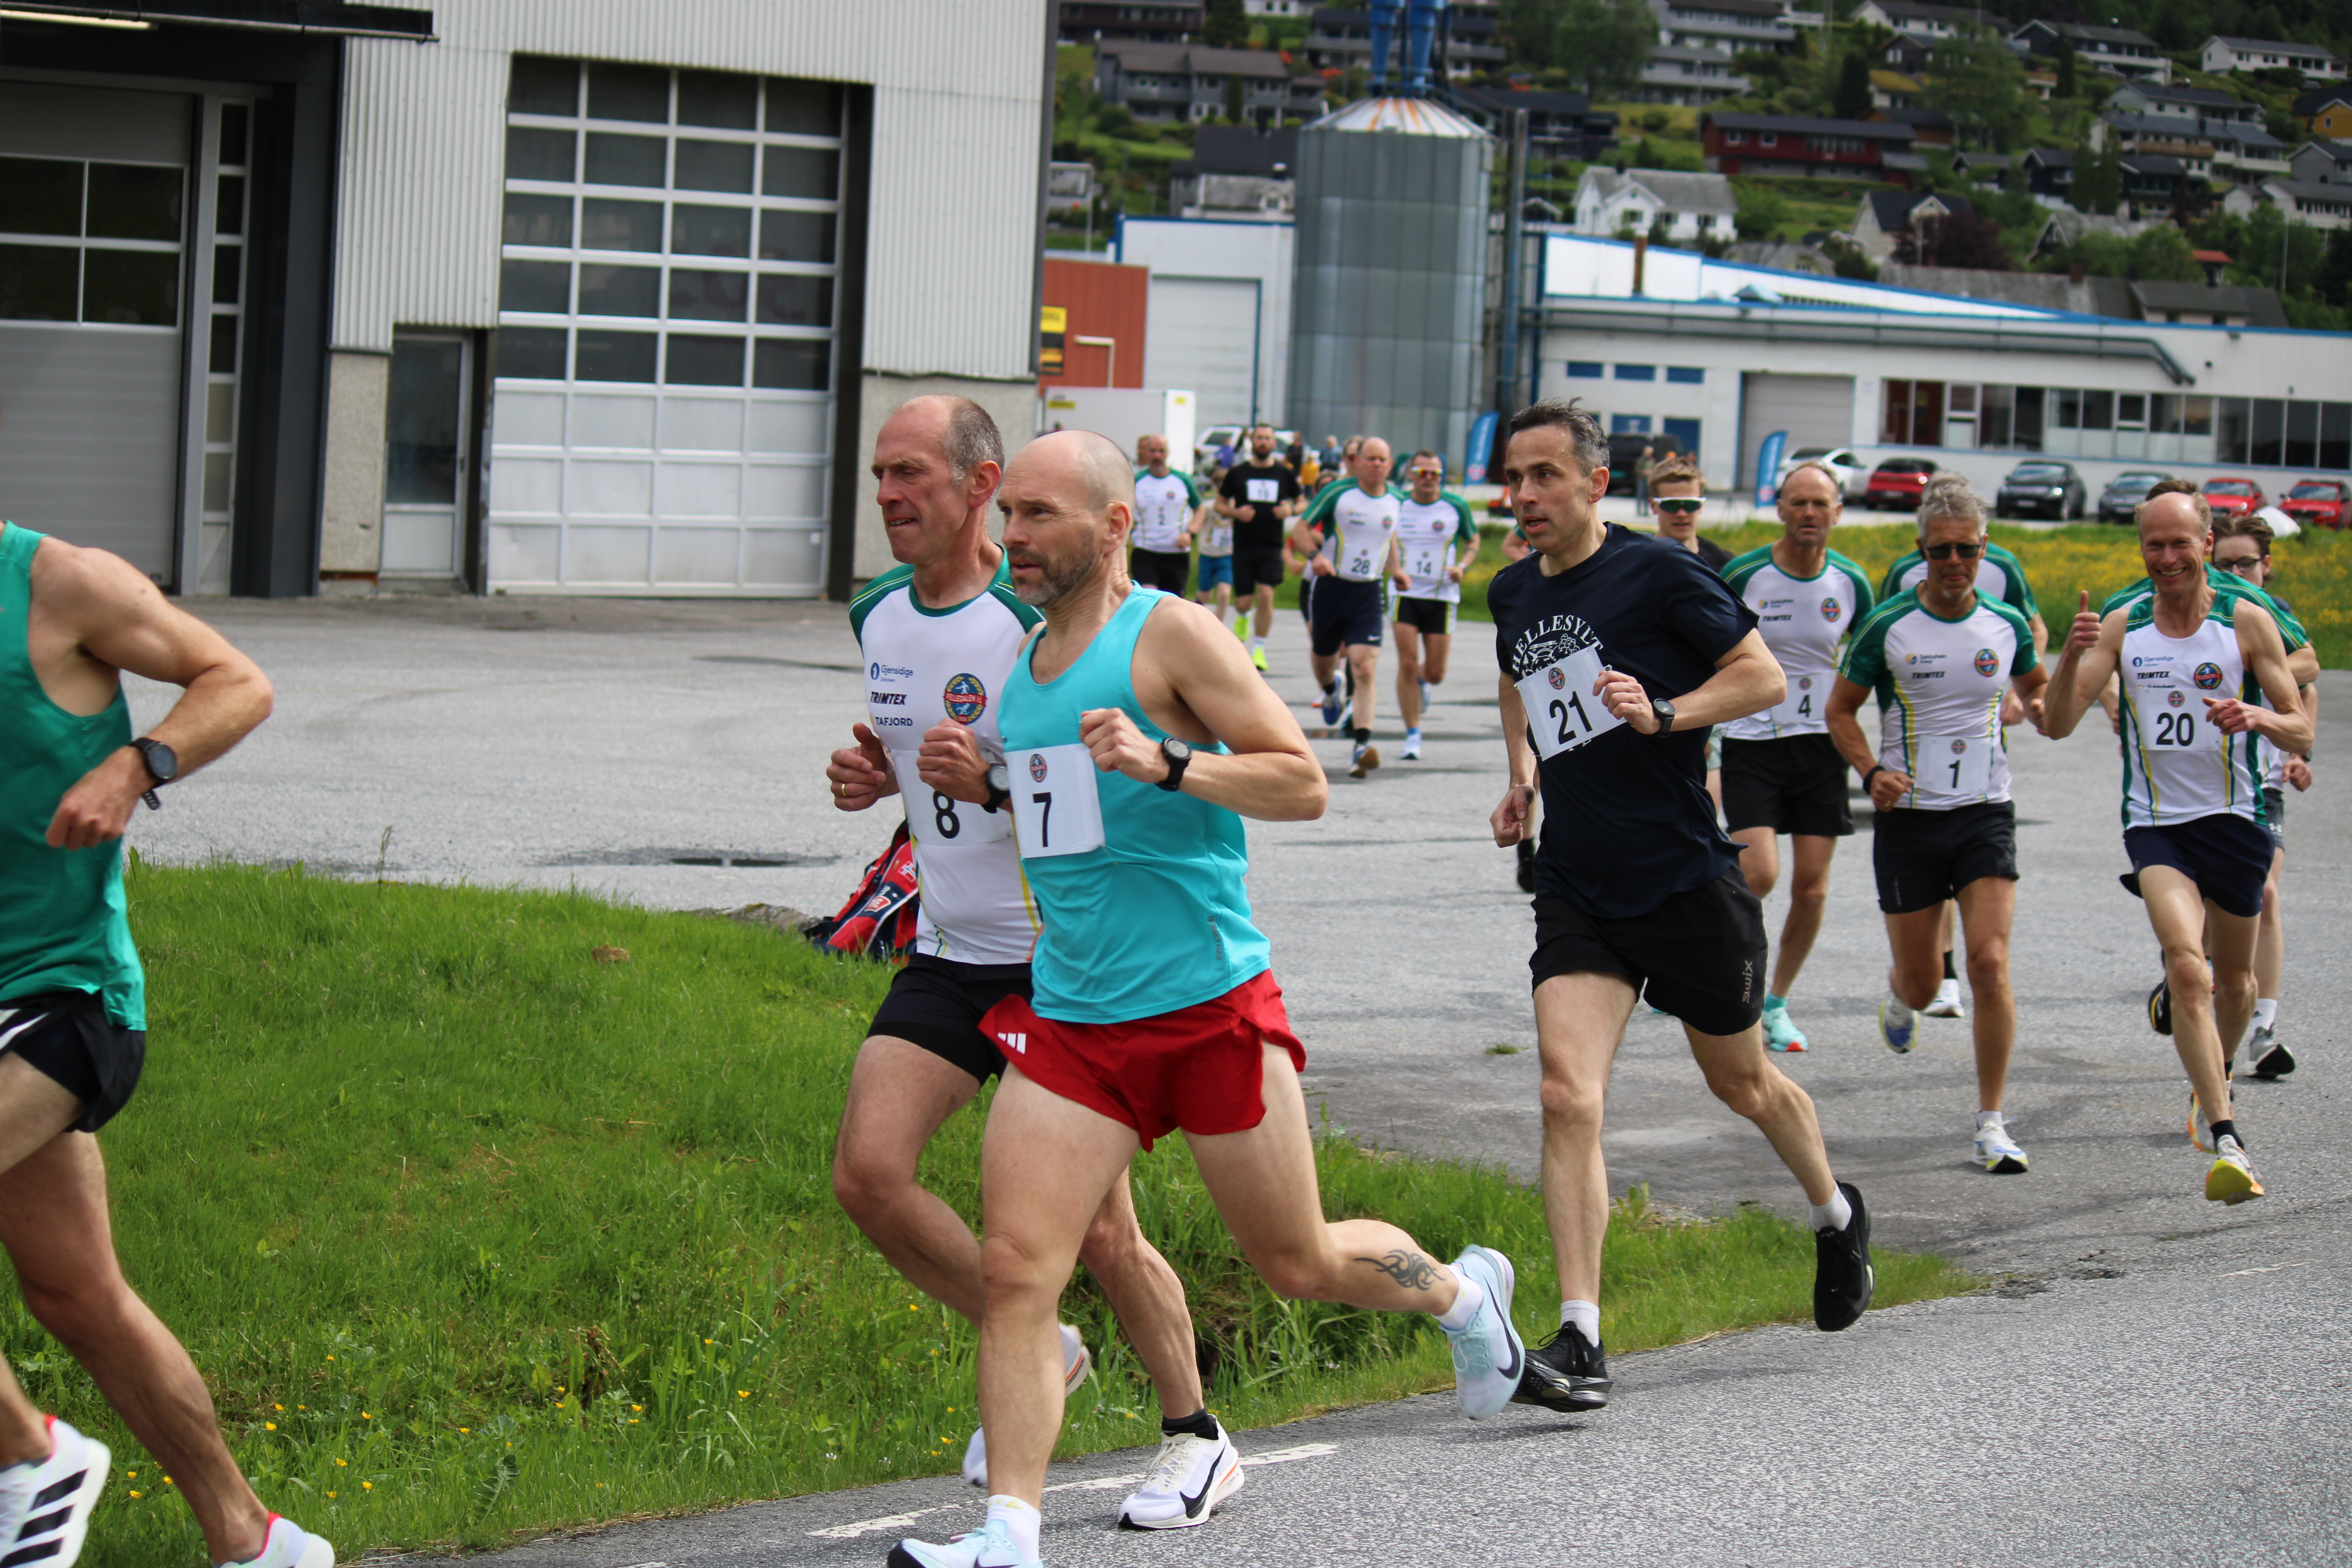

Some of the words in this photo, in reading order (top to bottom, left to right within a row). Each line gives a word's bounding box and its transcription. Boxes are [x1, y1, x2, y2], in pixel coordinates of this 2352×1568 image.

[1158, 514, 1165, 525] 2
[1352, 557, 1370, 574] 28
[1416, 561, 1432, 575] 14
[1512, 615, 1604, 674] HELLESYLT
[881, 664, 914, 678] Gjensidige
[1912, 671, 1945, 679] TRIMTEX
[2137, 671, 2171, 680] TRIMTEX
[870, 691, 907, 705] TRIMTEX
[1798, 694, 1812, 718] 4
[875, 717, 913, 726] TAFJORD
[1550, 691, 1593, 745] 21
[2156, 712, 2195, 747] 20
[1949, 759, 1960, 788] 1
[933, 790, 960, 839] 8
[1033, 792, 1052, 847] 7
